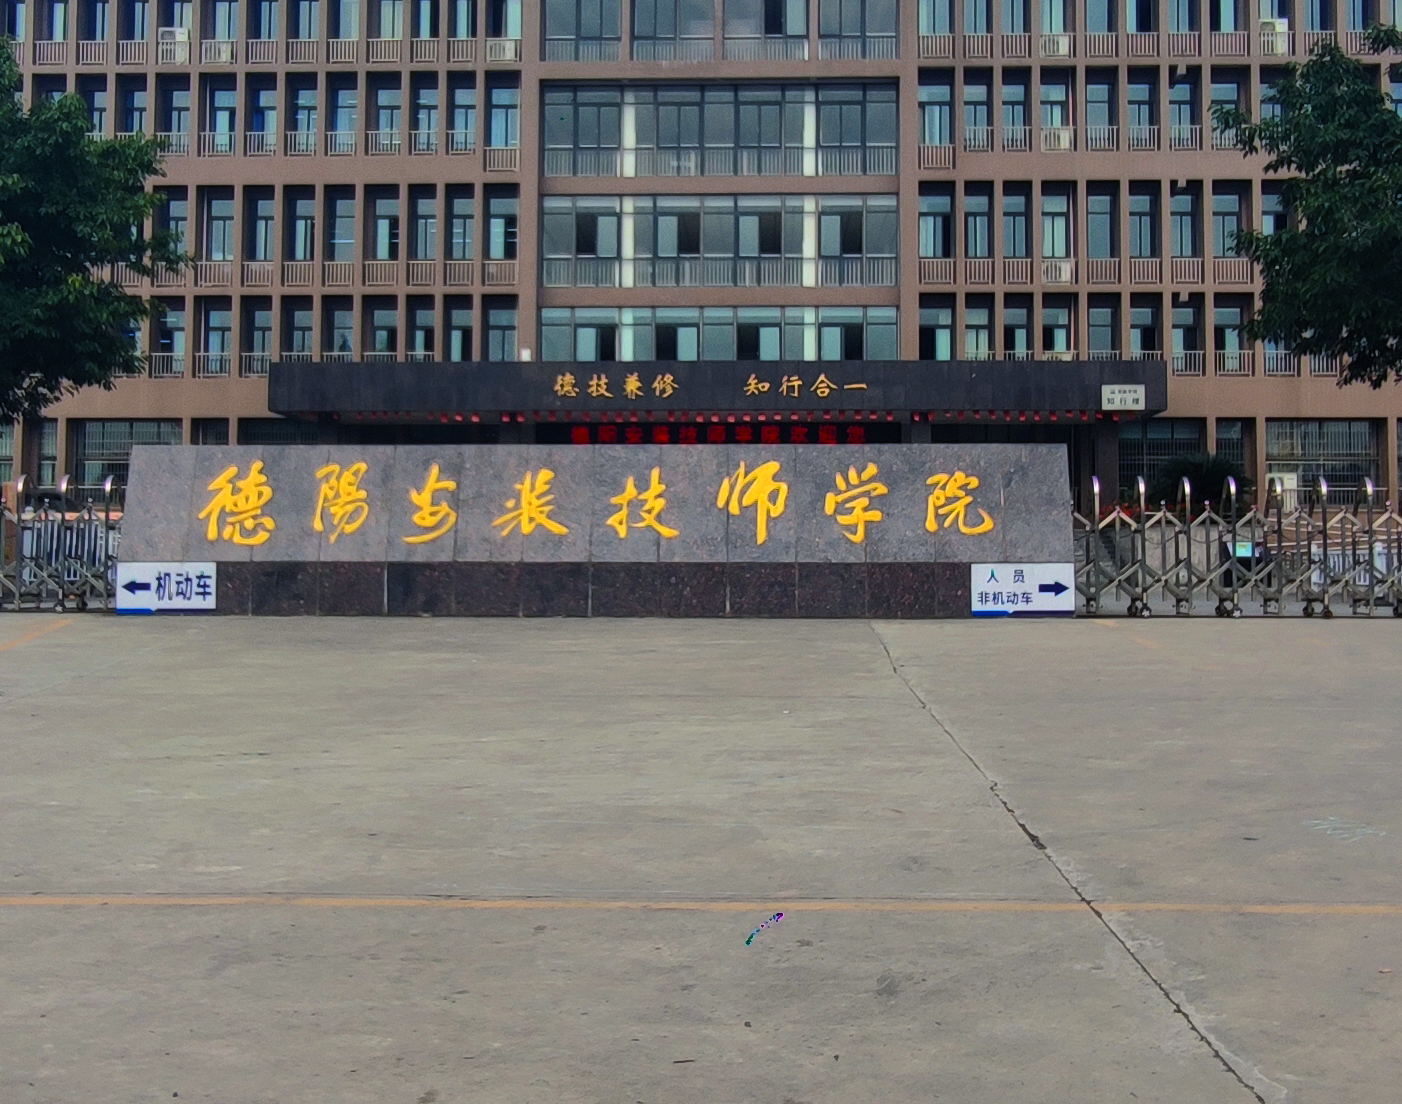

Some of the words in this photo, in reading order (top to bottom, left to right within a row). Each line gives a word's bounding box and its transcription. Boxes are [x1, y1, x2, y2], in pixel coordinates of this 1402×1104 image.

[553, 372, 679, 399] 德技兼修
[743, 373, 868, 397] 知行合一
[155, 571, 213, 602] 机动车
[986, 568, 1025, 584] 人员
[977, 591, 1034, 606] 非机动车
